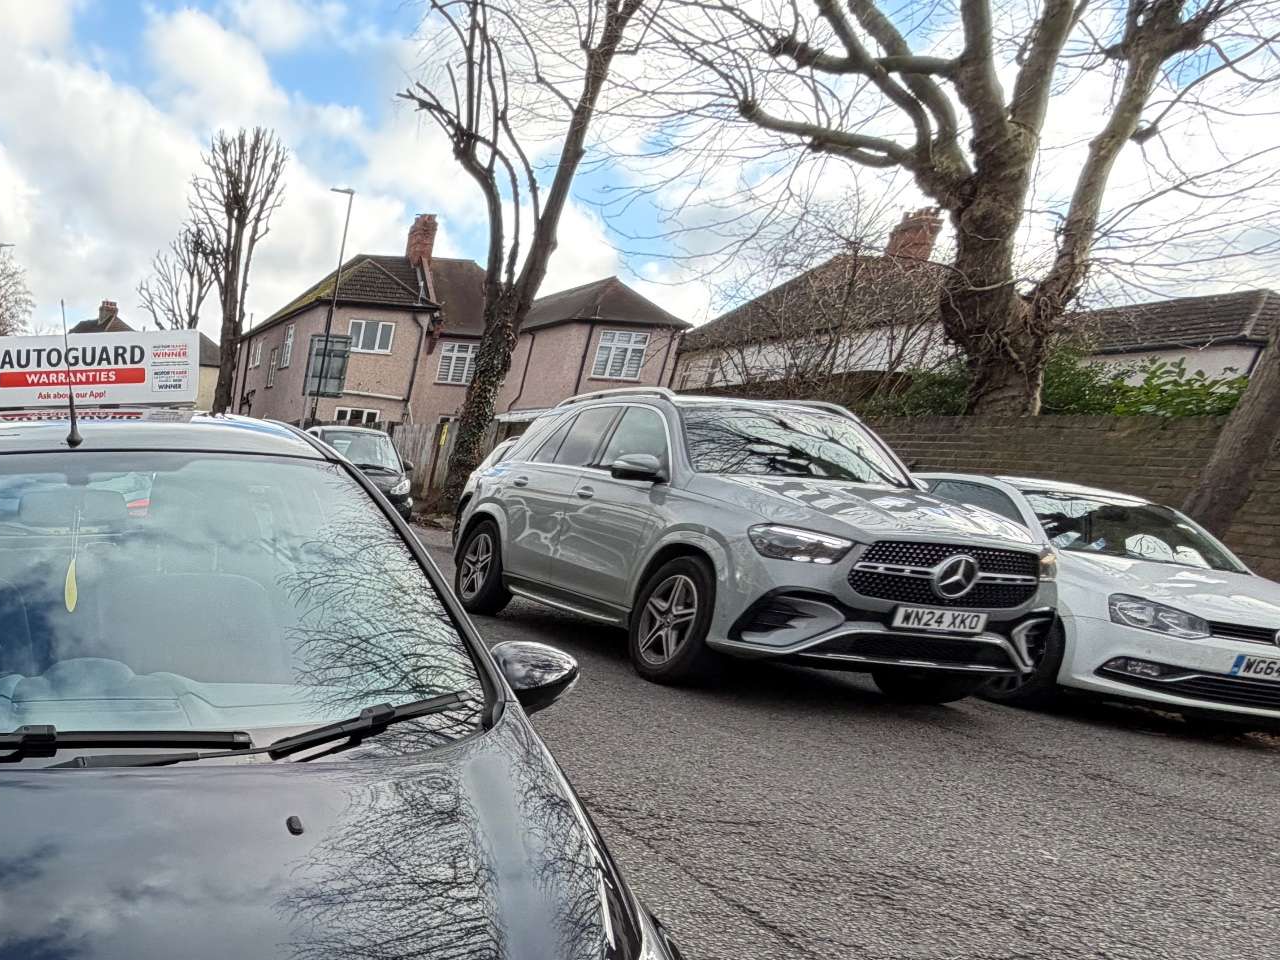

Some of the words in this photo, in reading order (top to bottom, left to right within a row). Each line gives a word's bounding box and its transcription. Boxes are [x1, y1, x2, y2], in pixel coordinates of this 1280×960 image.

[0, 345, 145, 370] AUTOGUARD
[25, 371, 117, 385] WARRANTIES
[38, 391, 52, 400] Ask
[88, 390, 106, 399] App!
[901, 608, 946, 628] WN24
